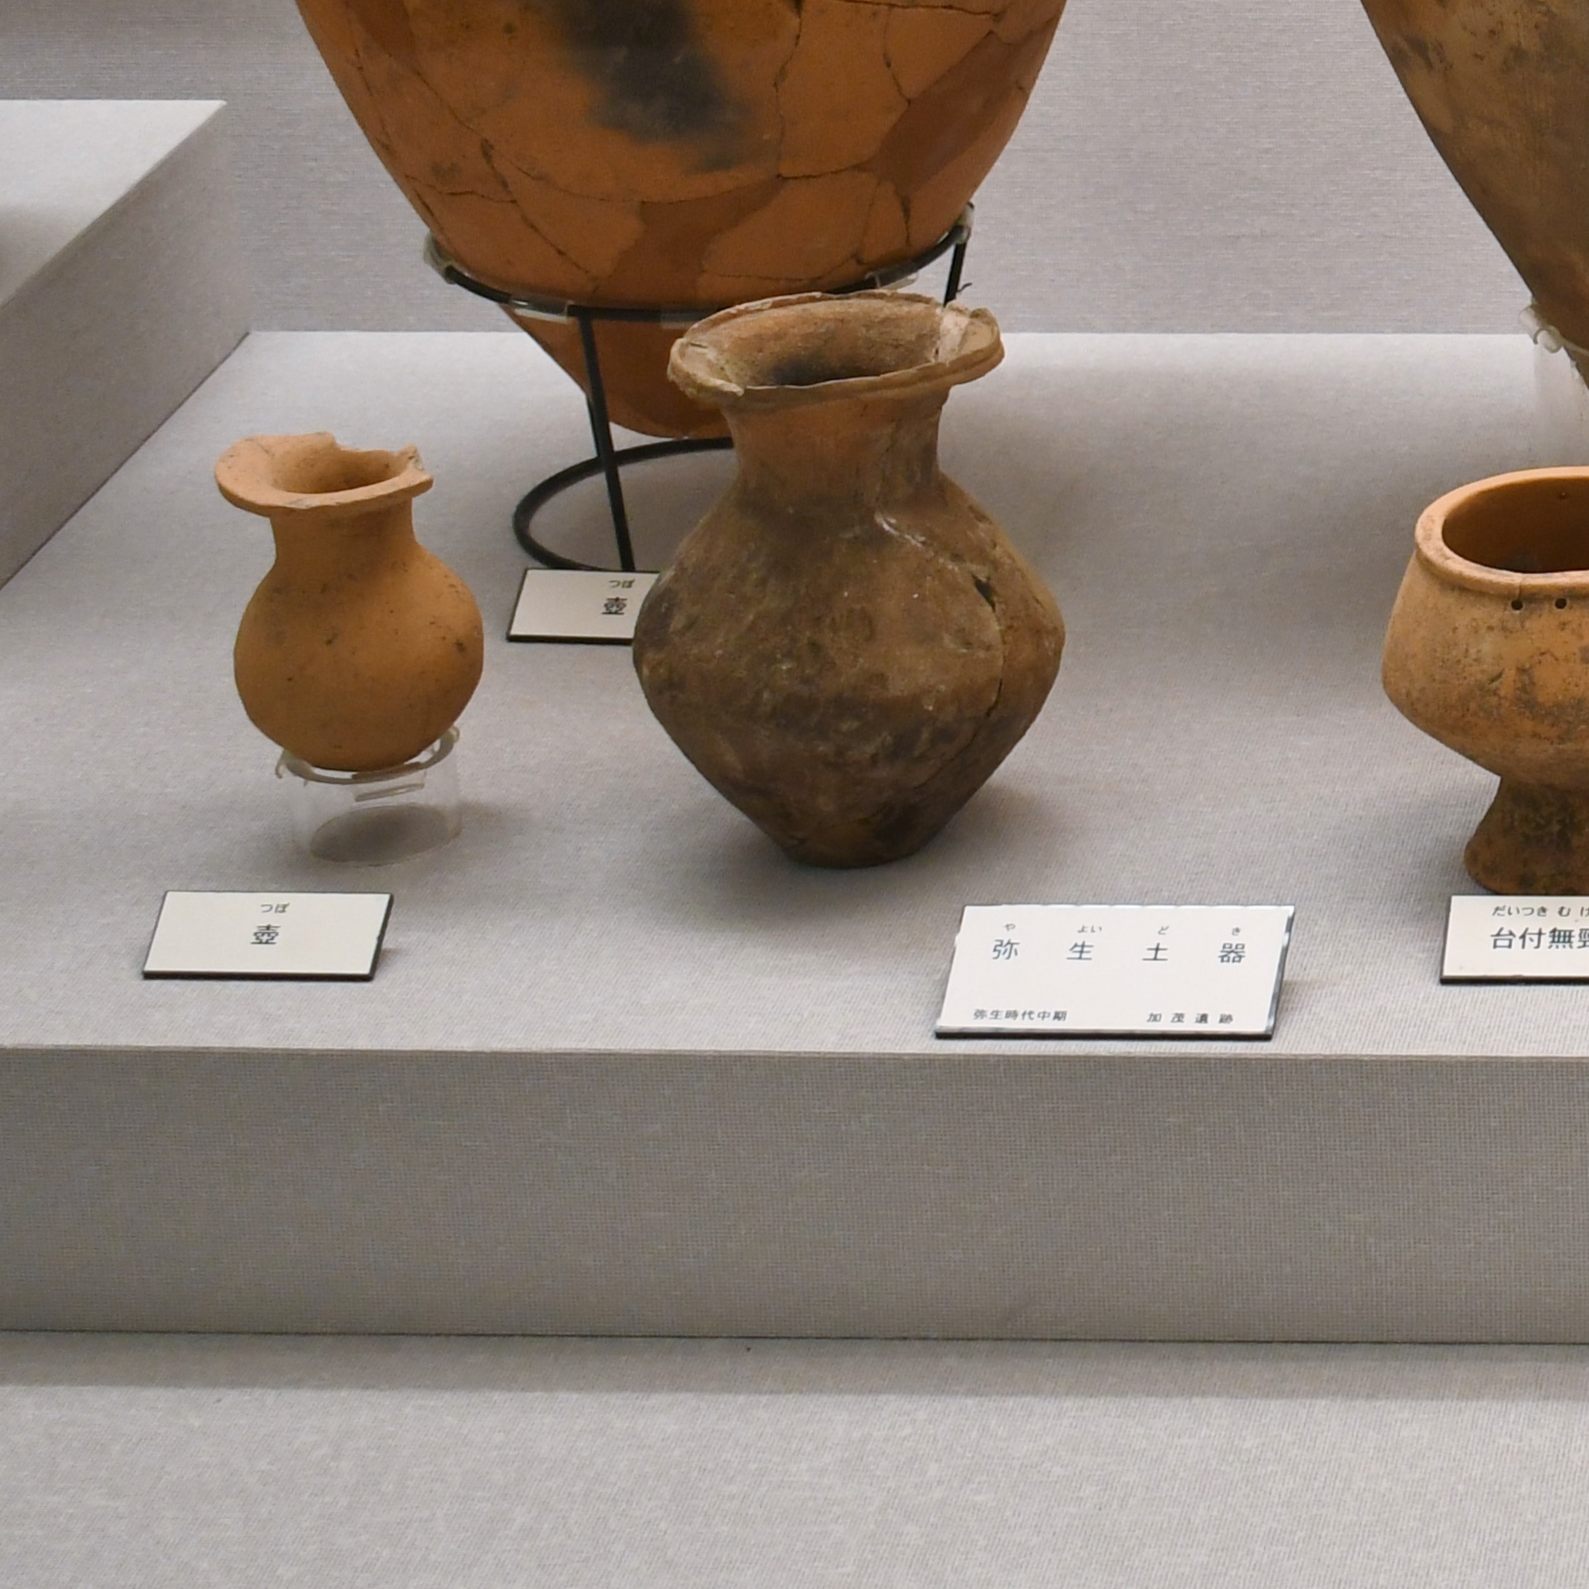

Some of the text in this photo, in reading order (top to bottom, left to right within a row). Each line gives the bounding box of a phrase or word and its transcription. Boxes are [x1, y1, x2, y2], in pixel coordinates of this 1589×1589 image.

[973, 1008, 1068, 1022] 弥生時代中期
